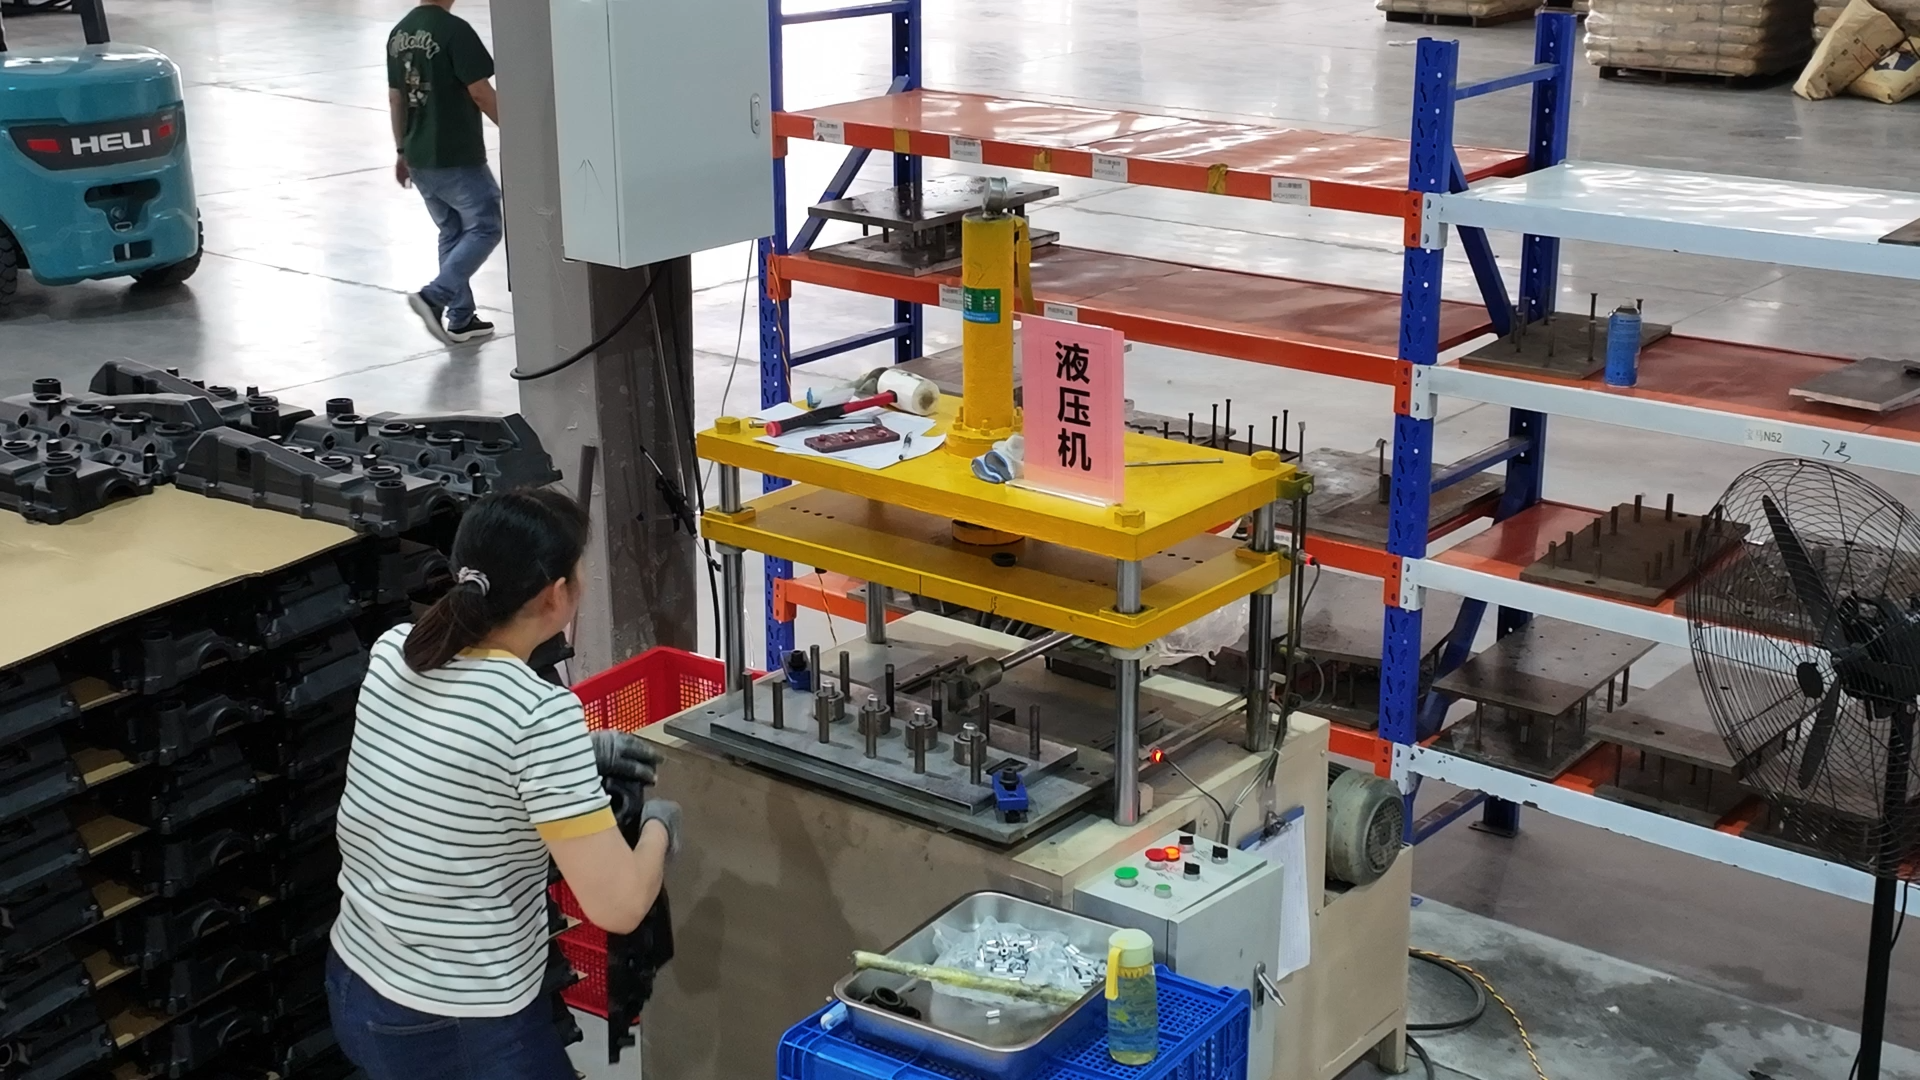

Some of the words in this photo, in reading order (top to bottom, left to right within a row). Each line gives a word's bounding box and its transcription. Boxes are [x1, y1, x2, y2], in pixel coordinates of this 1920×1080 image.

[70, 128, 152, 156] HELI
[1055, 340, 1092, 472] 液压机
